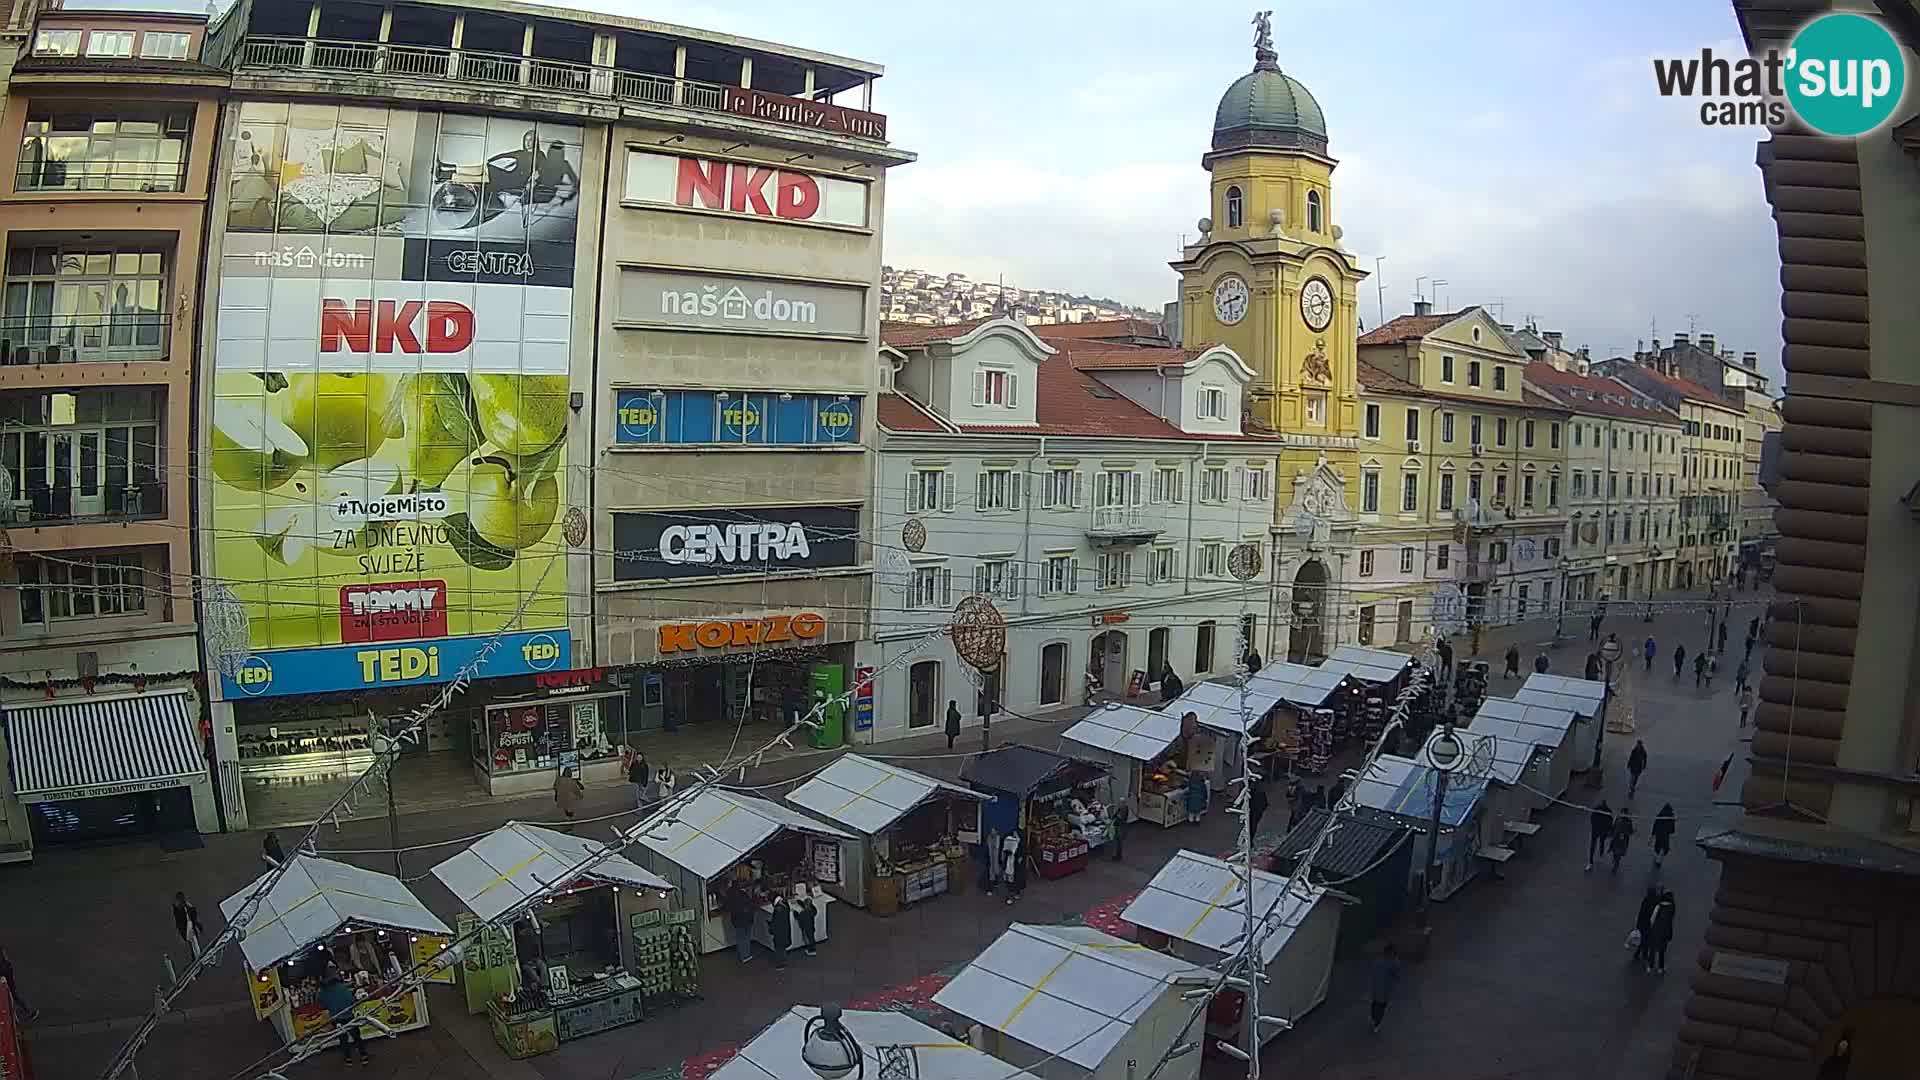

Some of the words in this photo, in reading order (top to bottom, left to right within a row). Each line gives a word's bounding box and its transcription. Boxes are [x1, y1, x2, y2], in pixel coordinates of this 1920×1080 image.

[723, 89, 745, 111] Le
[676, 157, 821, 219] NKD
[254, 246, 294, 268] naš
[319, 248, 365, 269] dom
[448, 250, 535, 276] CENTRA
[661, 285, 718, 316] naš
[753, 290, 817, 323] dom
[320, 297, 477, 354] NKD
[618, 408, 657, 426] TEDi
[723, 409, 760, 426] TEDi
[819, 411, 853, 428] TEDi
[338, 498, 446, 517] #TvojeMisto
[333, 529, 357, 549] ZA
[365, 525, 450, 548] DNEVNO
[659, 522, 810, 564] CENTRA
[359, 548, 425, 576] SVJEŽE
[348, 588, 440, 615] TOMMY
[658, 613, 825, 654] KORZO
[521, 642, 560, 661] TEDi
[235, 666, 273, 686] TEDi
[357, 647, 439, 683] TEDi
